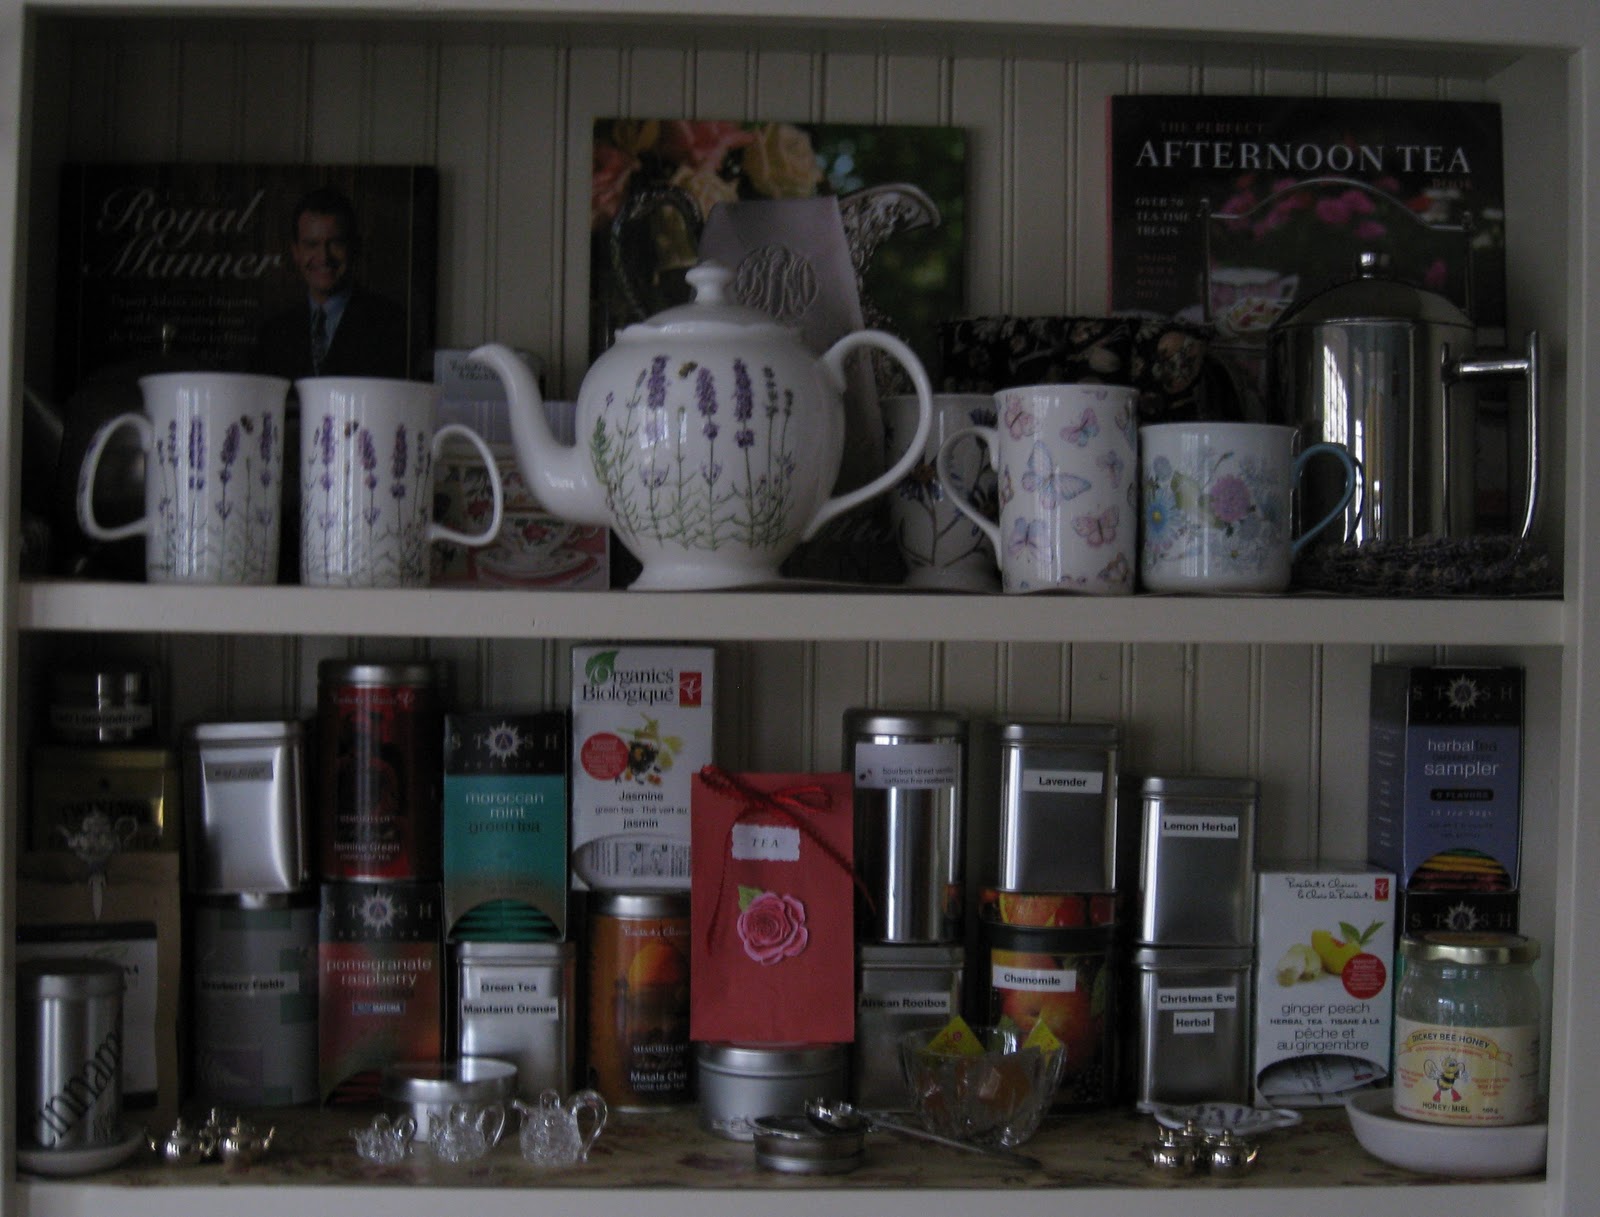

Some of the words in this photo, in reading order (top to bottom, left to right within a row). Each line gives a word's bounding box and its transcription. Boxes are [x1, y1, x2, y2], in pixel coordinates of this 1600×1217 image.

[1135, 140, 1382, 173] AFTERNOON
[1395, 145, 1472, 174] TEA
[97, 188, 265, 248] Royal
[589, 666, 674, 687] Organics
[1424, 761, 1499, 779] sampler
[1039, 776, 1087, 788] Lavender
[465, 791, 545, 805] moroccan
[618, 791, 664, 801] Jasmine
[490, 805, 526, 819] mint
[622, 818, 659, 830] jasmin
[1163, 821, 1199, 831] Lemon
[1202, 821, 1237, 832] Herbal
[751, 838, 779, 848] TEA
[326, 956, 433, 974] pomegranate
[252, 978, 285, 988] Fields
[341, 970, 417, 988] raspberry
[1003, 973, 1061, 986] Chamomile
[480, 983, 514, 993] Green
[518, 983, 537, 993] Tea
[861, 999, 900, 1008] African
[902, 998, 948, 1008] Rooibos
[1160, 993, 1214, 1004] Christmas
[1216, 993, 1236, 1003] Eve
[463, 1005, 514, 1015] Mandarin
[1281, 1002, 1324, 1016] ginger
[1328, 1002, 1370, 1016] peach
[1176, 1017, 1211, 1028] Herbal
[1294, 1027, 1339, 1041] pêche
[1341, 1029, 1356, 1039] et
[1276, 1041, 1293, 1050] au
[1294, 1039, 1370, 1053] gingembre
[1411, 1032, 1438, 1043] DICKEY
[1439, 1032, 1457, 1043] BEE
[1458, 1034, 1491, 1049] HONEY
[630, 1070, 666, 1082] Masala
[1422, 1101, 1446, 1112] HONEY
[1451, 1103, 1471, 1113] MIEL
